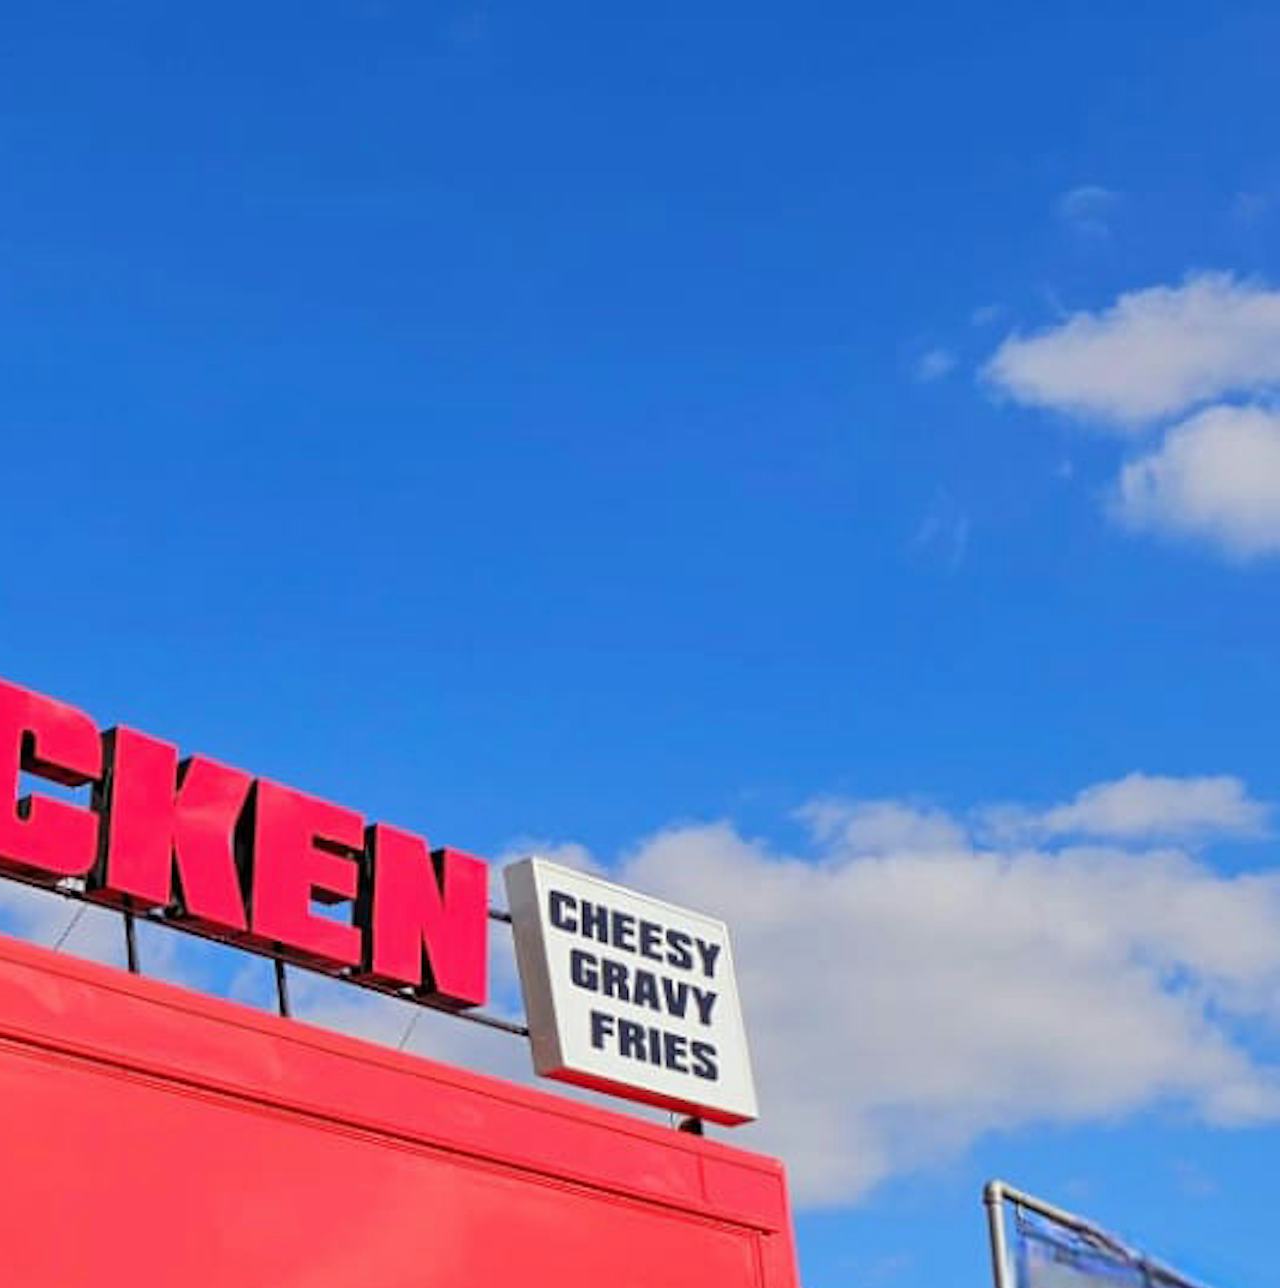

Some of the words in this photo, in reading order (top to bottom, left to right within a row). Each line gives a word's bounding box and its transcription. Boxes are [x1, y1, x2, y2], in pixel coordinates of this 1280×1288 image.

[548, 889, 721, 979] CHEESY
[569, 947, 719, 1027] GRAVY
[590, 1010, 719, 1082] FRIES
